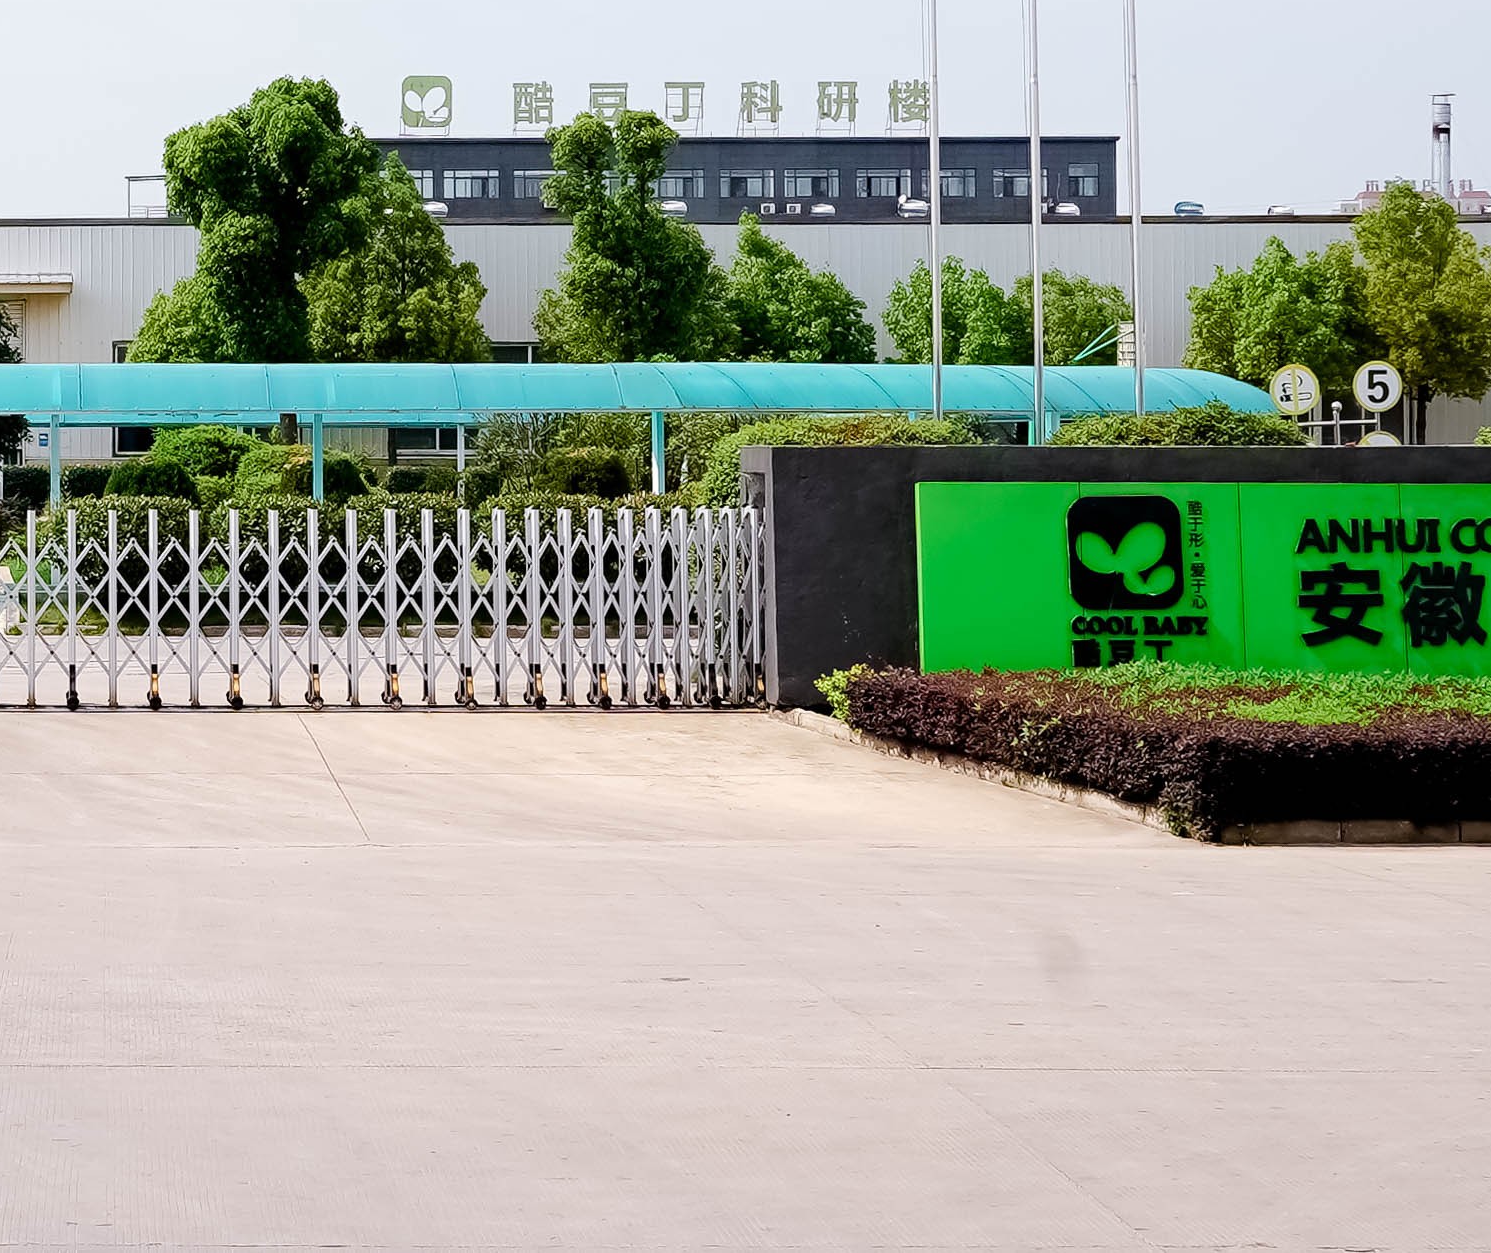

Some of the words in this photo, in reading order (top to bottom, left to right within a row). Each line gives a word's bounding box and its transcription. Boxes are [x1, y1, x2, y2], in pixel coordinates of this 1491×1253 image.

[512, 80, 930, 124] 酷豆丁科研楼
[1367, 370, 1390, 403] 5
[1295, 517, 1441, 555] ANHUI
[1070, 615, 1138, 636] COOL
[1142, 615, 1209, 636] BABY
